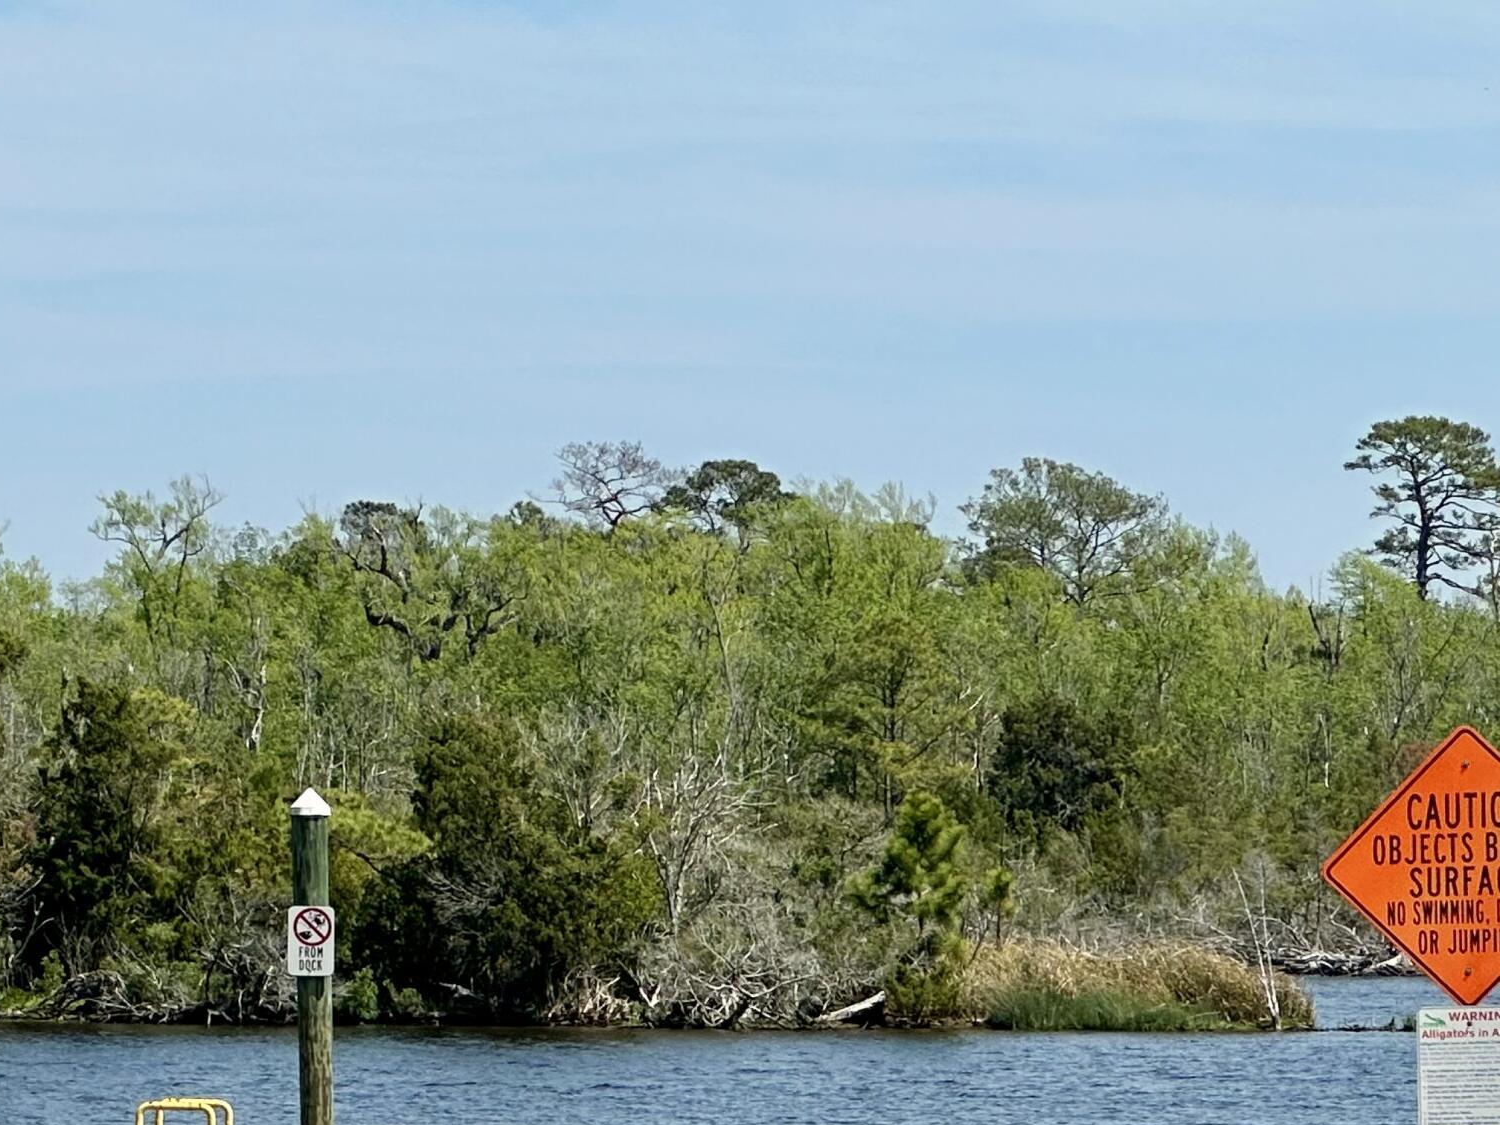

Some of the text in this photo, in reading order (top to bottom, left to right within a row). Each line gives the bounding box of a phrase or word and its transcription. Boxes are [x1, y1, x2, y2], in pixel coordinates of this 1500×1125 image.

[1373, 832, 1474, 865] OBJECTS
[1409, 865, 1500, 898] SURFA
[1387, 901, 1406, 926] NO
[1413, 900, 1490, 926] SWIMMING,
[299, 946, 324, 958] FROM
[1419, 929, 1500, 955] OR JUMPI
[299, 960, 323, 972] DOCK
[1422, 1029, 1475, 1040] Alligators
[1478, 1028, 1489, 1037] in
